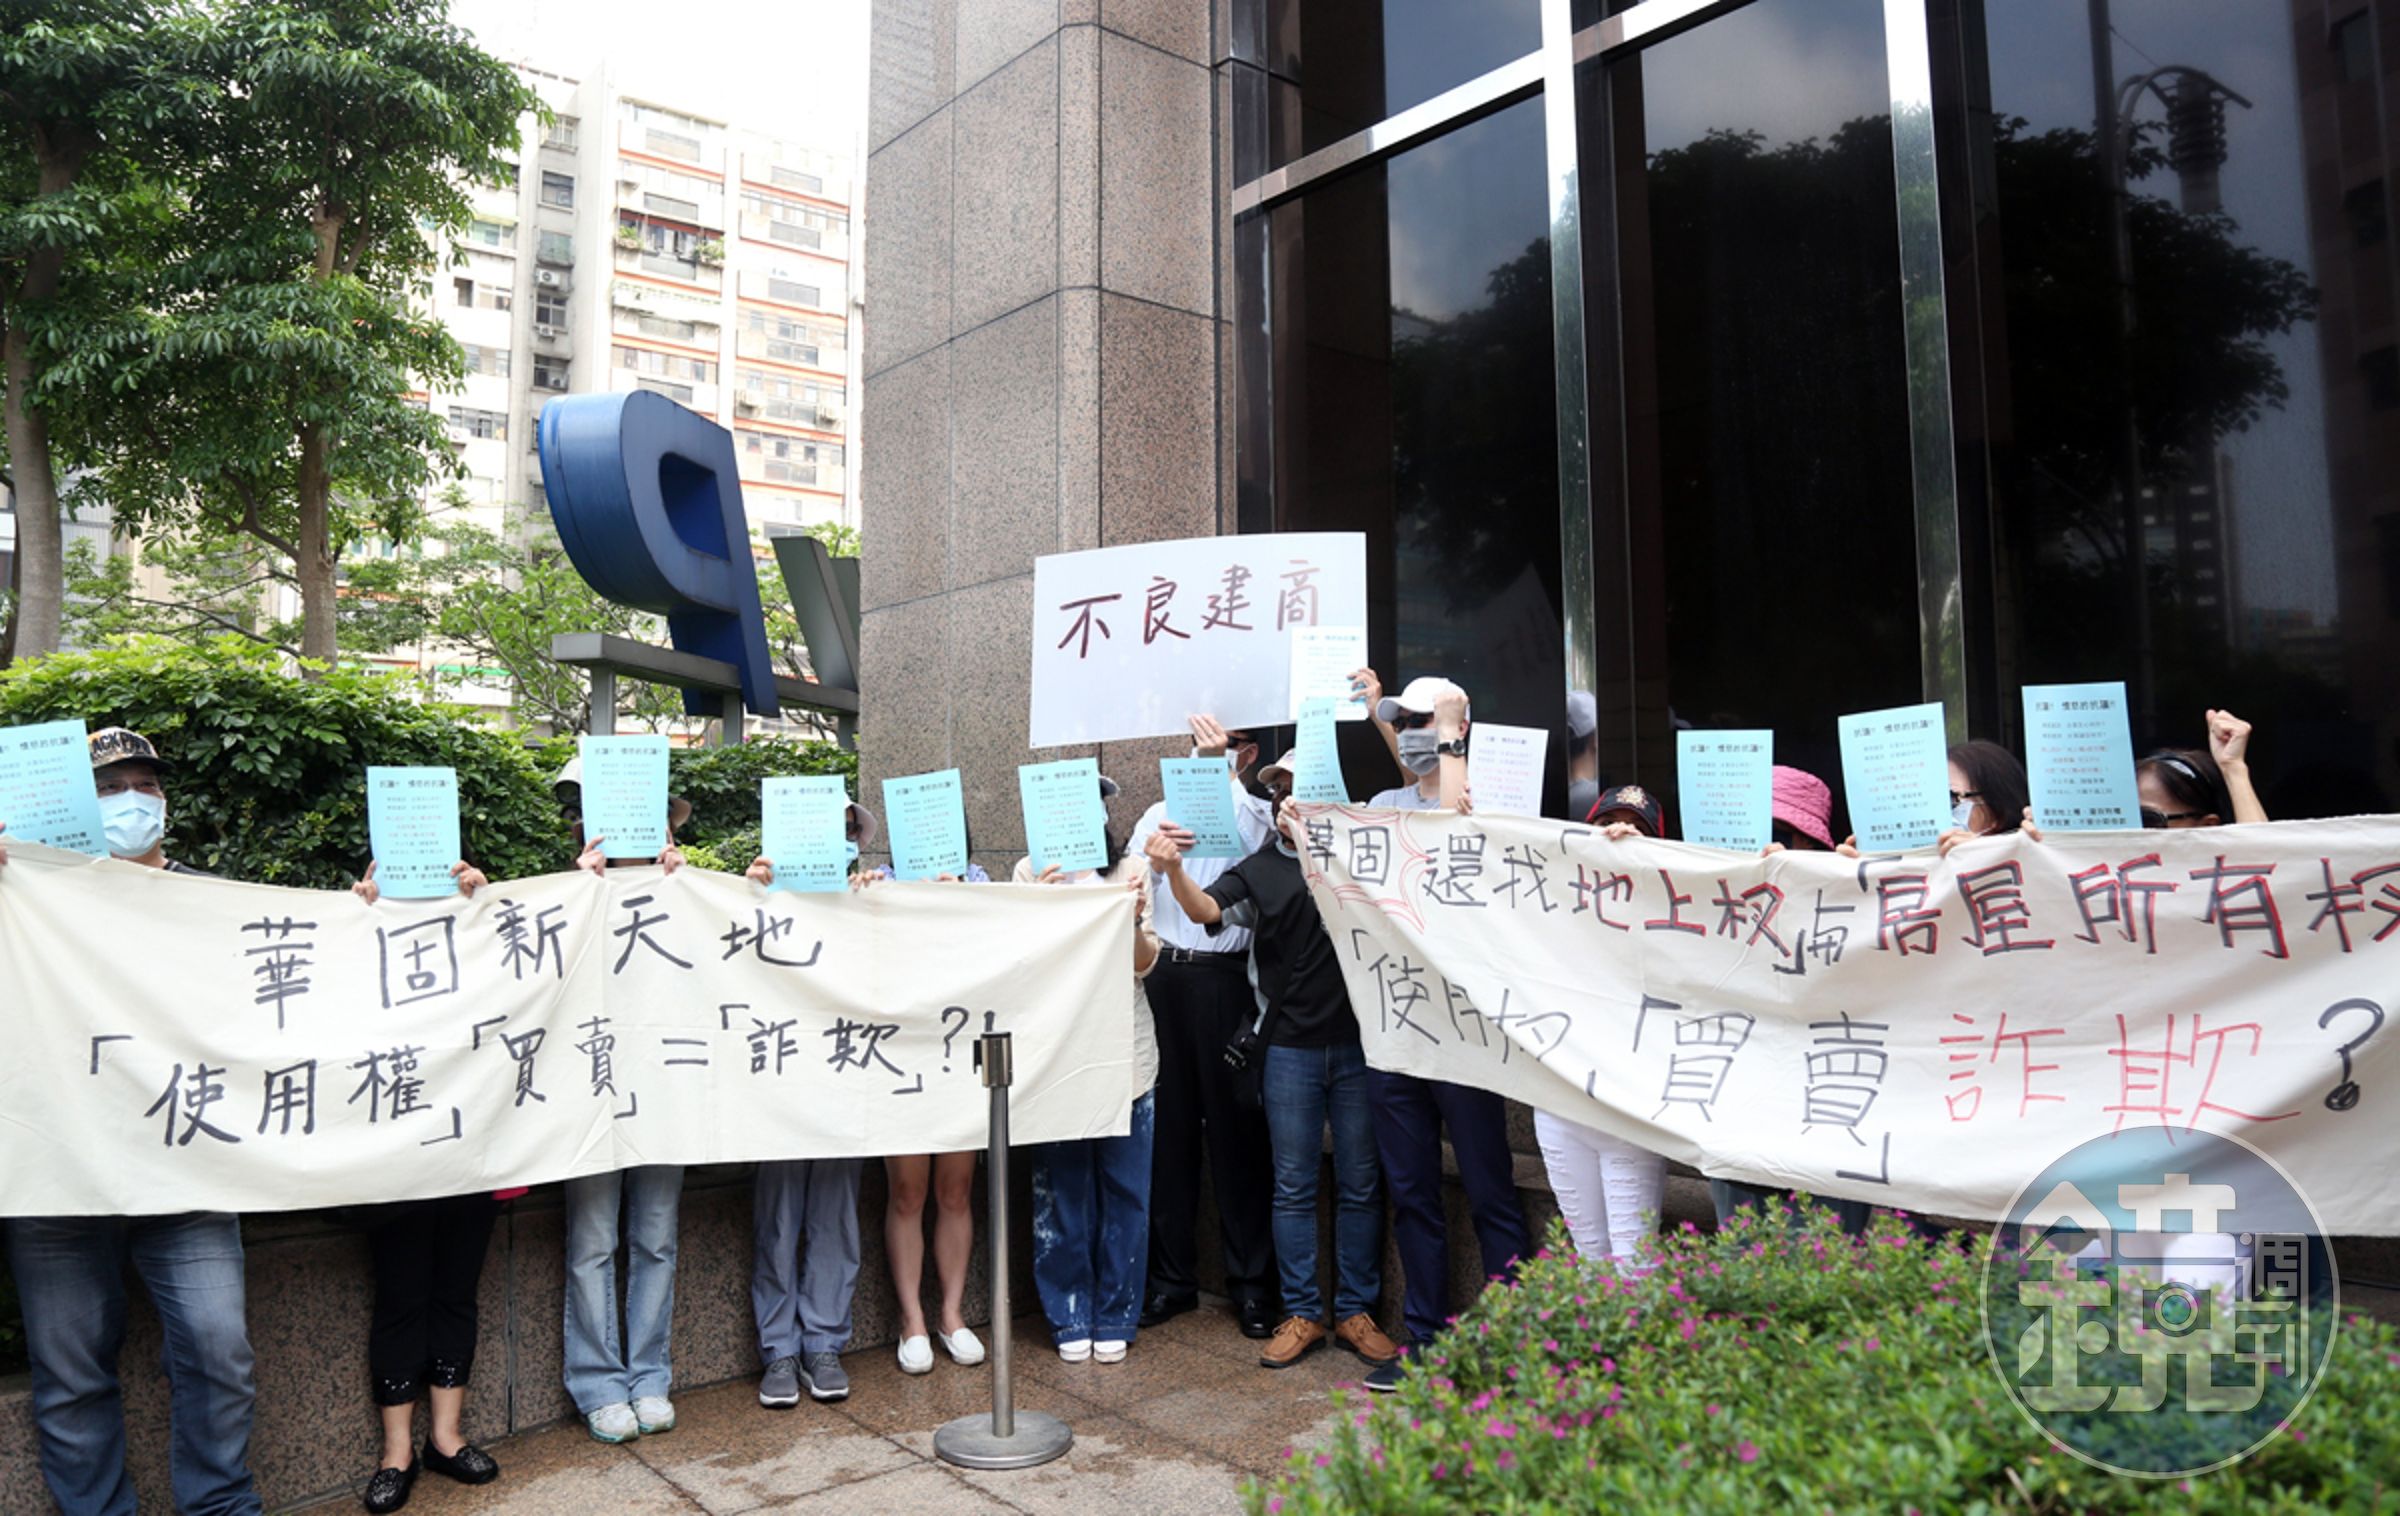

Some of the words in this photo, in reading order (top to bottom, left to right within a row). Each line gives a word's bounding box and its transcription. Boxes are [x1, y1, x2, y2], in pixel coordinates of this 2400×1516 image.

[1057, 558, 1322, 659] 不良建商
[240, 894, 822, 1030] 華固新天地
